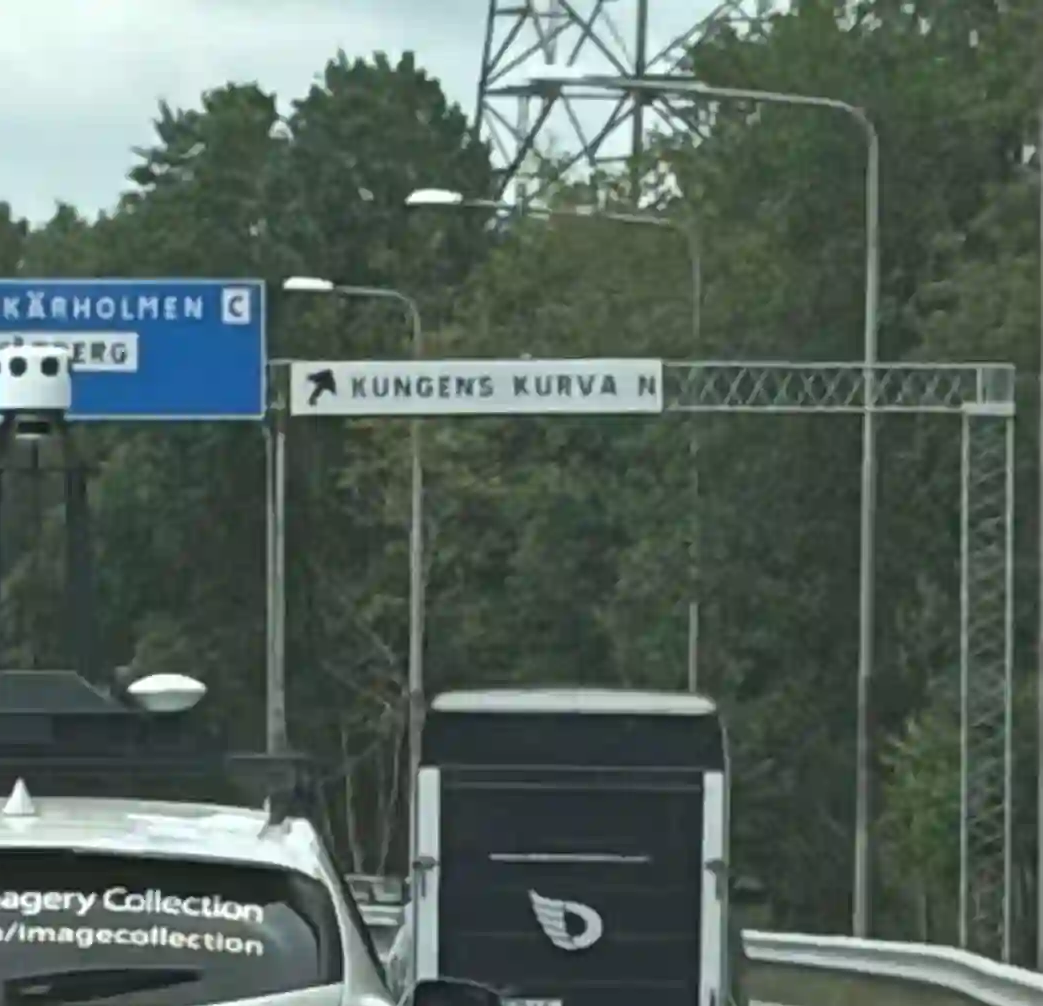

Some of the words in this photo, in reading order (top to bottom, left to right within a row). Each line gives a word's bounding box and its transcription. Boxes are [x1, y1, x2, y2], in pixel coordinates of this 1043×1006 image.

[351, 374, 494, 398] KUNGENS
[513, 373, 617, 397] KURVA
[638, 374, 656, 397] N
[103, 886, 264, 924] Collection
